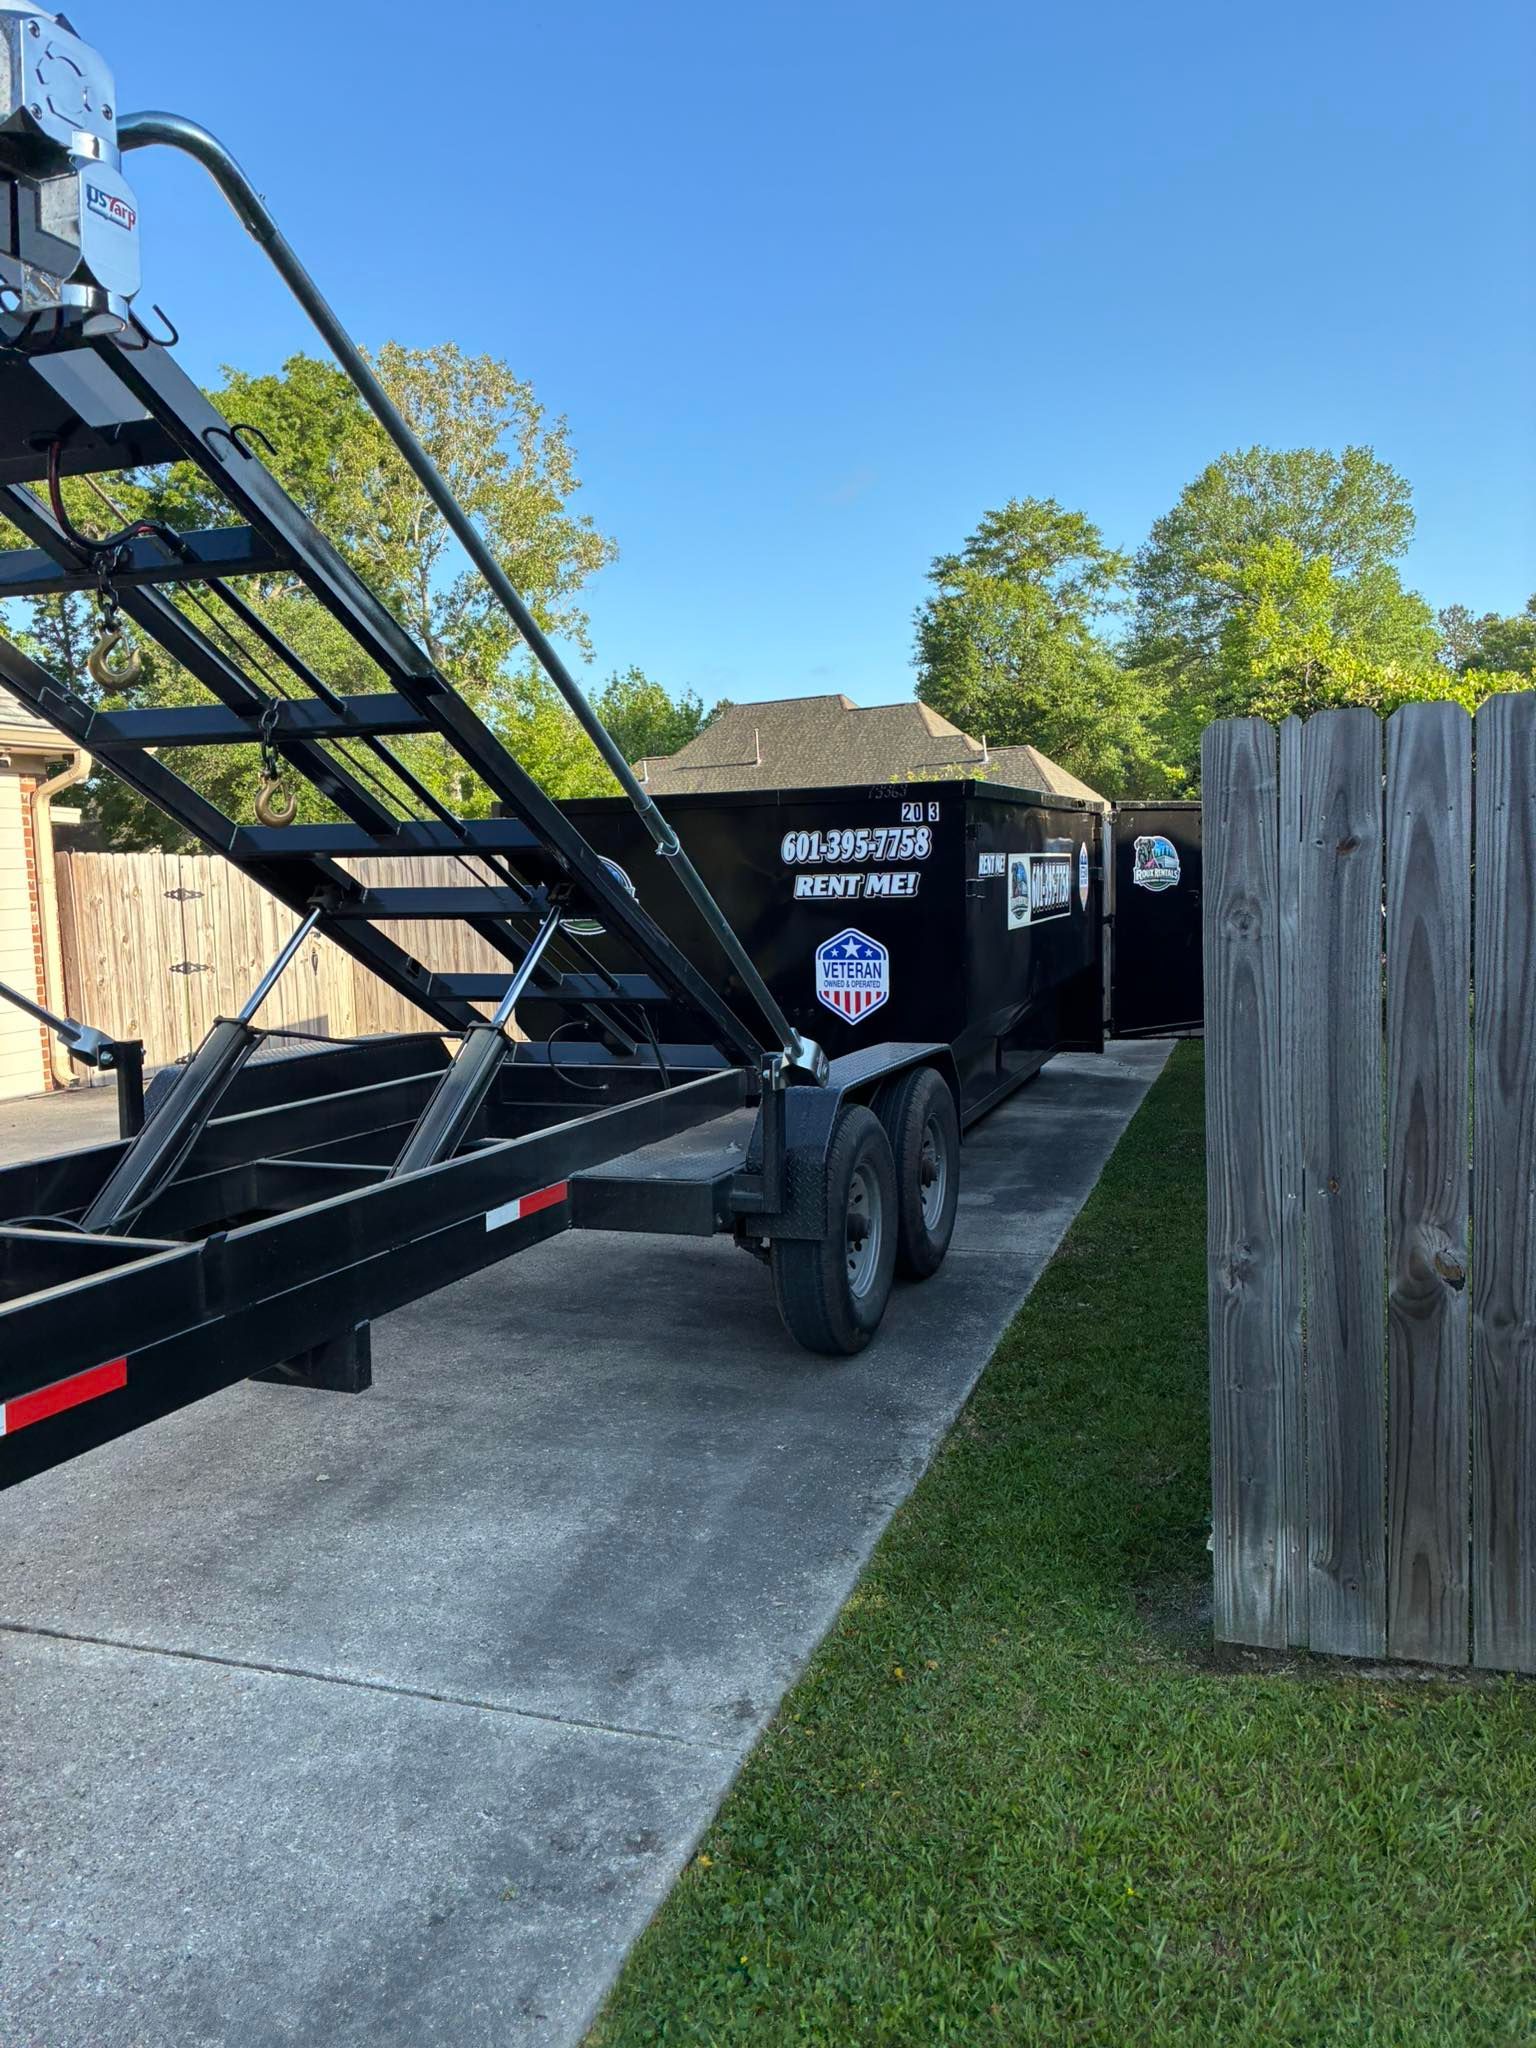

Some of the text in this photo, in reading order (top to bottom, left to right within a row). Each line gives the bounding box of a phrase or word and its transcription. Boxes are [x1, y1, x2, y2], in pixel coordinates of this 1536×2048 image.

[782, 826, 932, 863] 601-395-7758
[794, 872, 919, 898] RENT ME!
[823, 961, 882, 979] VETERAN
[824, 980, 881, 989] OWNED & OPERATED
